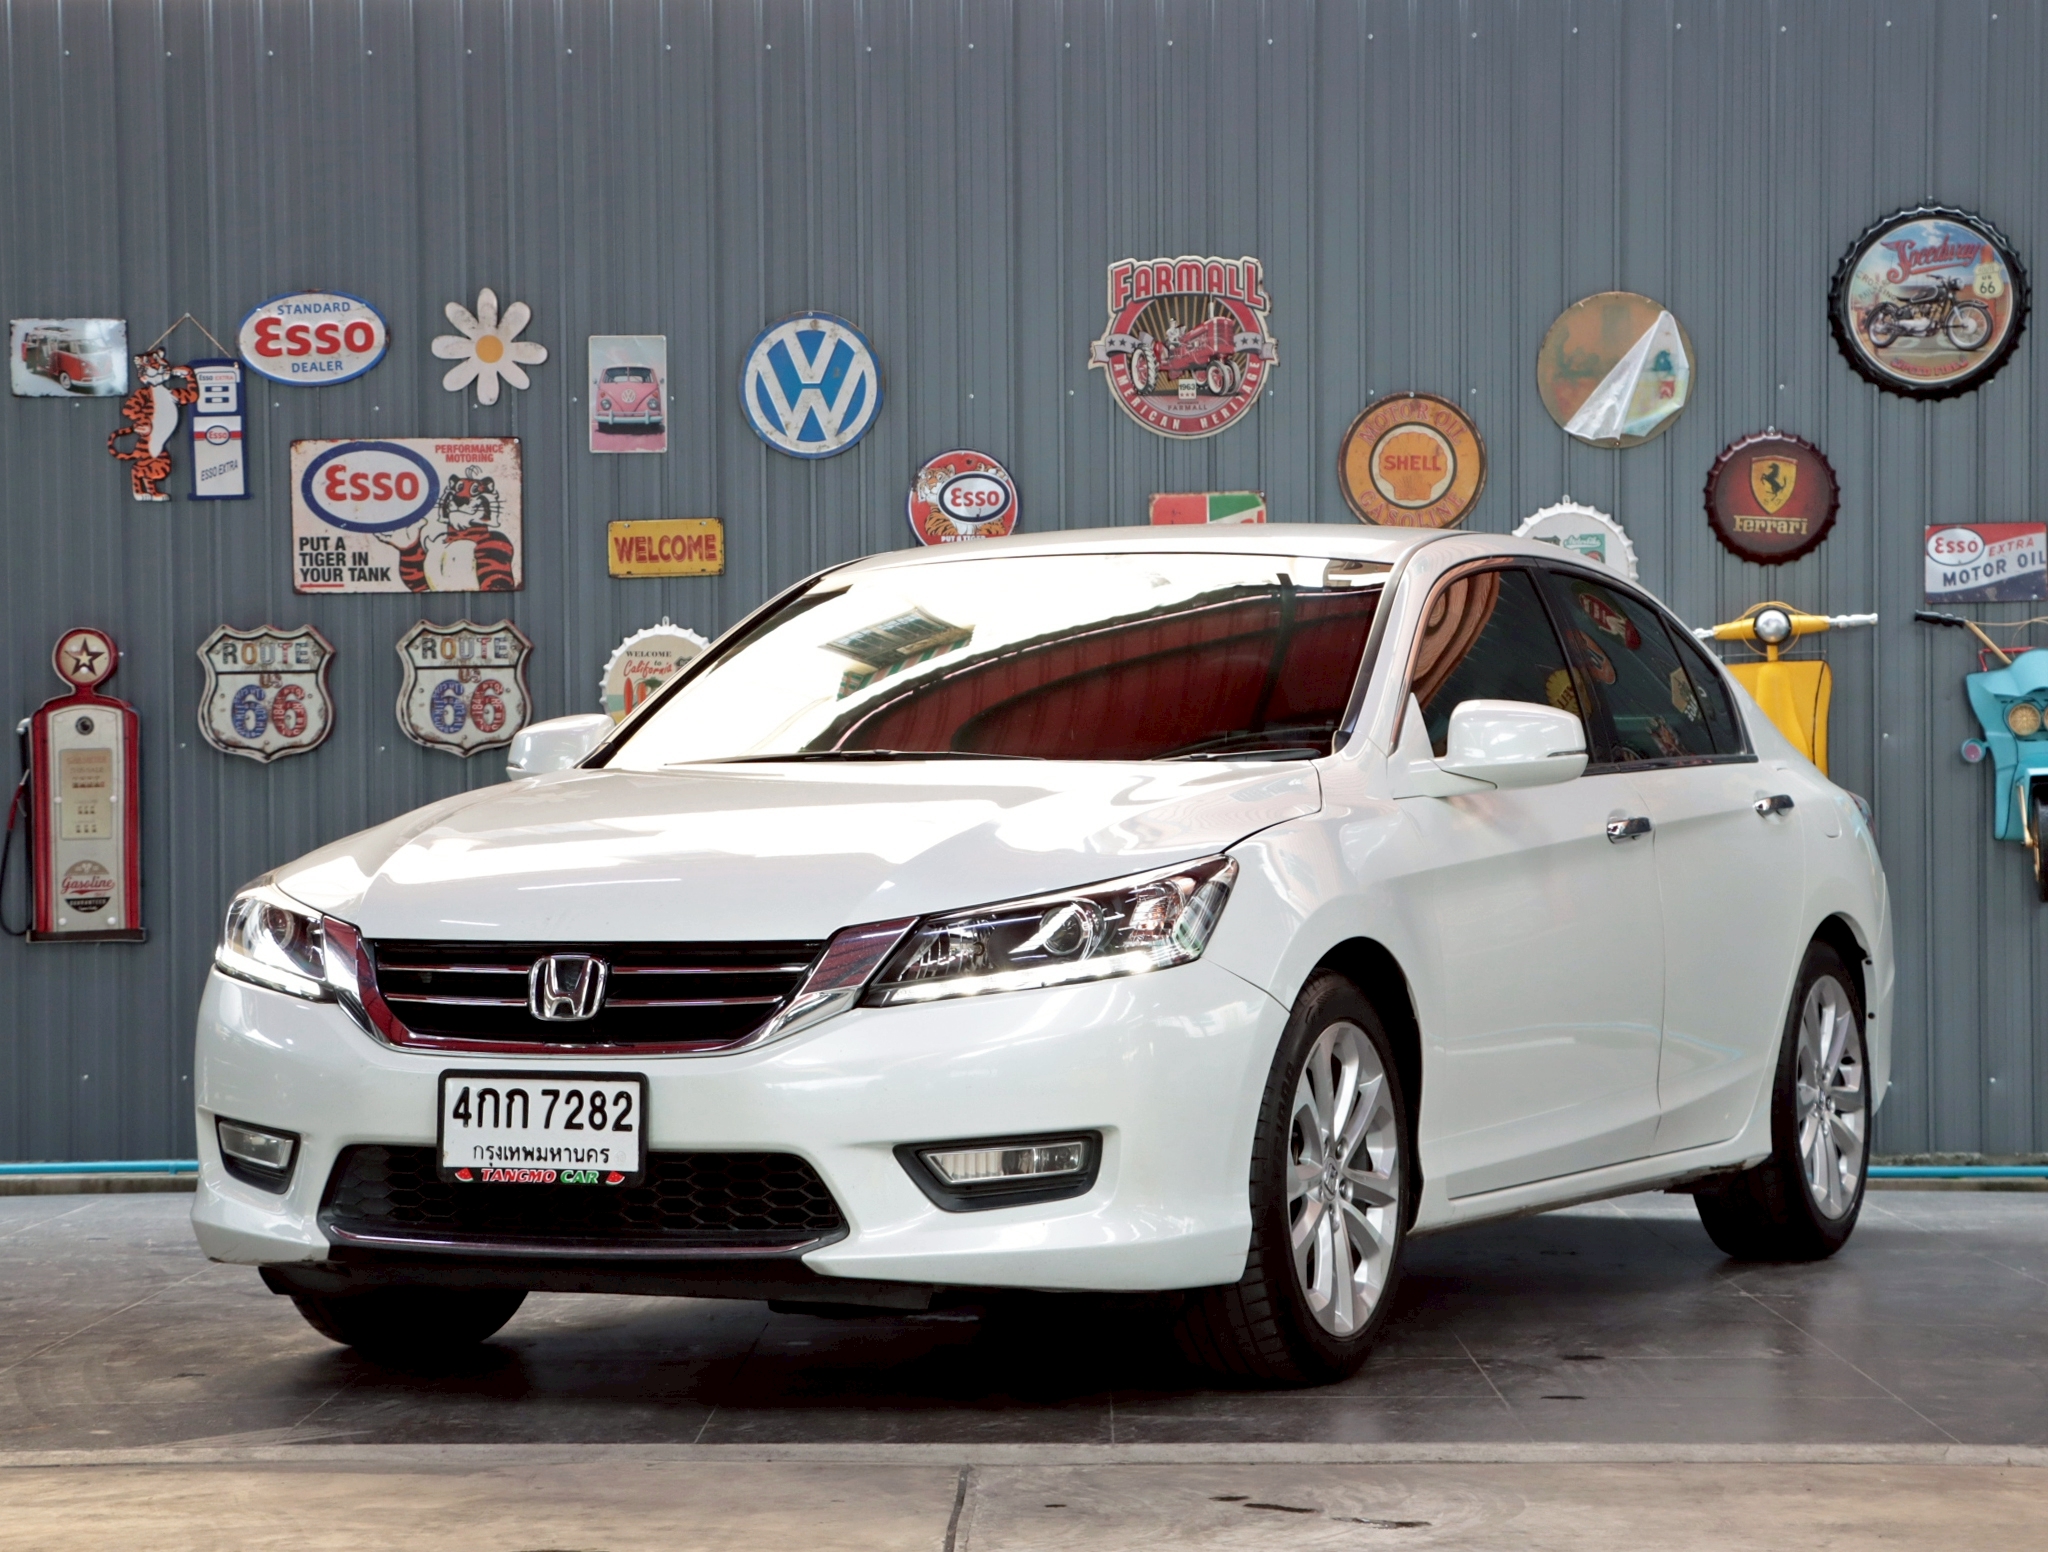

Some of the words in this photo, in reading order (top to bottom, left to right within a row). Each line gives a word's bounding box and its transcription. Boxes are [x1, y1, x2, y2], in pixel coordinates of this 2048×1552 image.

[1880, 234, 1981, 284] Speedway
[1111, 260, 1266, 312] FARMALL
[1979, 281, 1996, 294] 66
[277, 301, 351, 315] STANDARD
[254, 316, 375, 358] Esso
[291, 360, 344, 373] DEALER
[1113, 362, 1181, 430] AMERICAN
[1199, 360, 1261, 430] HERITAGE
[1179, 383, 1196, 391] 1963
[1358, 401, 1430, 447] MOTOR
[1433, 409, 1468, 447] OIL
[435, 444, 504, 454] PERFORMANCE
[445, 453, 494, 463] MOTORING
[201, 466, 217, 481] ESSO
[218, 459, 239, 475] EXTRA
[1384, 454, 1442, 472] SHELL
[325, 464, 420, 501] Esso
[950, 487, 1000, 508] Esso
[1358, 490, 1467, 528] GASOLINE
[1732, 514, 1808, 535] Ferrari
[299, 536, 331, 551] PUT
[334, 536, 347, 551] A
[613, 533, 718, 565] WELCOME
[941, 535, 955, 543] PUT
[1934, 536, 1979, 554] Esso
[1988, 537, 2035, 557] EXTRA
[299, 552, 347, 567] TIGER
[352, 552, 369, 567] IN
[1942, 558, 2007, 587] MOTOR
[2017, 550, 2046, 568] OIL
[299, 567, 344, 583] YOUR
[347, 567, 391, 582] TANK
[221, 642, 311, 665] ROUTE
[421, 637, 509, 660] ROUTE
[626, 650, 672, 658] WELCOME
[458, 667, 482, 684] US
[623, 659, 673, 679] California
[258, 672, 283, 689] US
[231, 684, 308, 739] 66
[430, 678, 506, 734] 66
[61, 875, 115, 895] Gasoline
[452, 1086, 529, 1128] 4กก
[541, 1089, 633, 1132] 7282
[473, 1144, 610, 1167] กรุงเทพมหานคร
[480, 1168, 557, 1183] TANGMO
[560, 1170, 600, 1184] CAR
